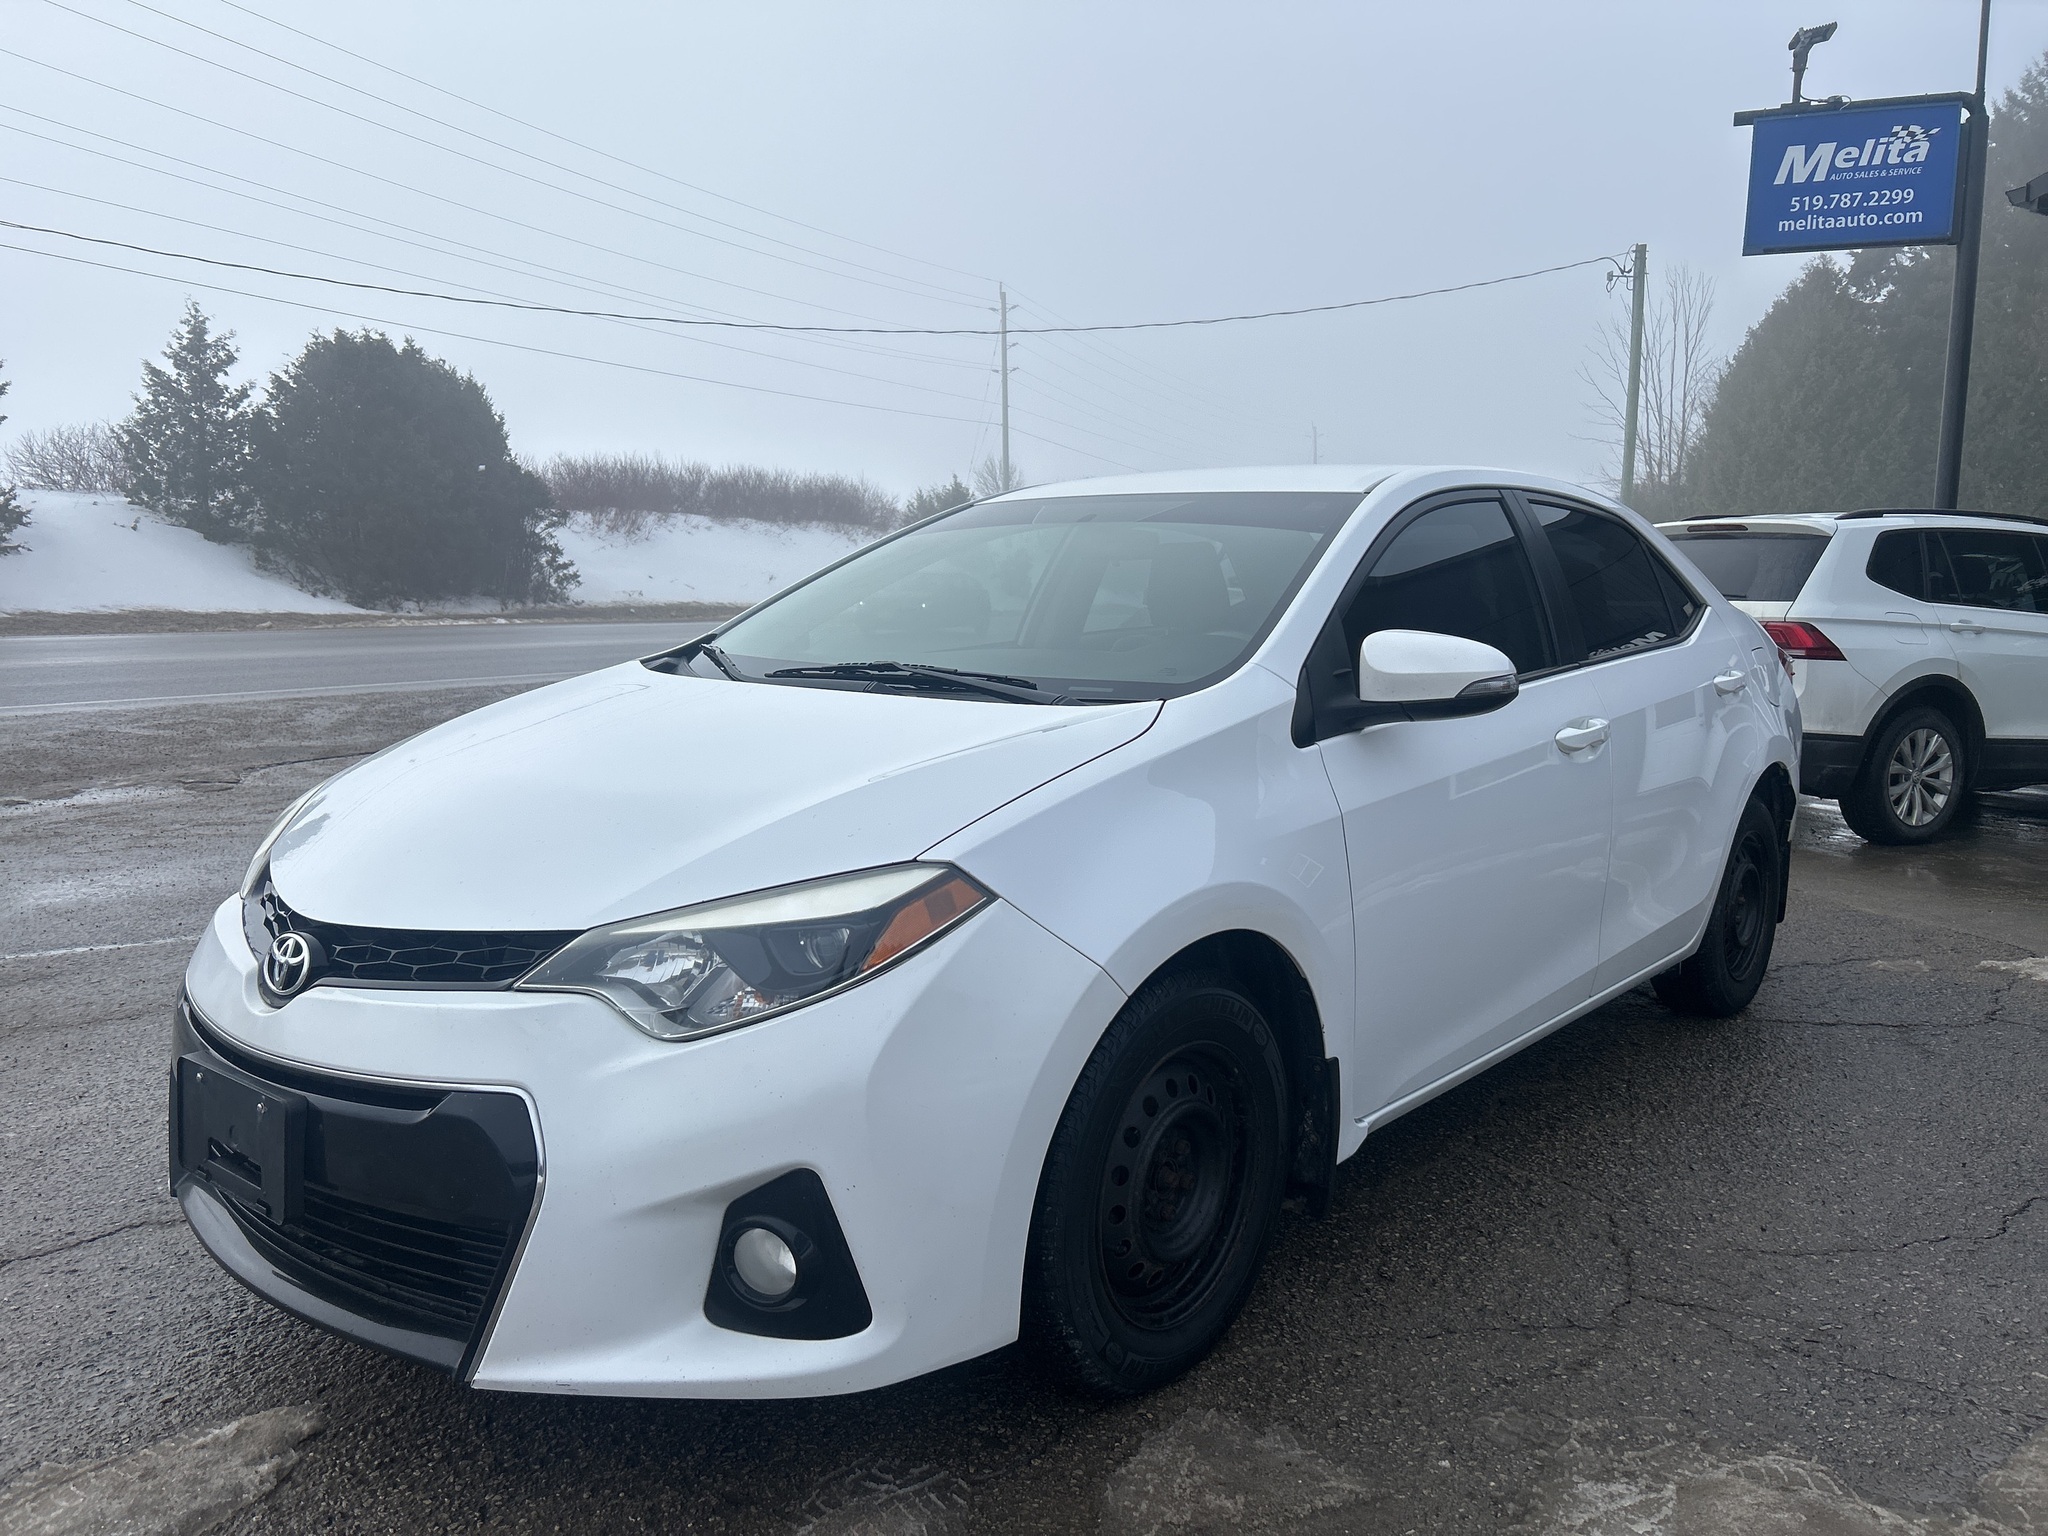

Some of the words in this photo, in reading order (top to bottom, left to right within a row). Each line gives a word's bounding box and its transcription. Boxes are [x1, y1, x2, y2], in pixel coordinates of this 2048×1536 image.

[1773, 137, 1930, 185] Melita
[1830, 172, 1853, 181] AUTO
[1854, 170, 1879, 179] SALES
[1880, 169, 1887, 177] &
[1889, 167, 1922, 176] SERVICE
[1790, 188, 1914, 212] 519.787.2299
[1779, 211, 1923, 232] melitaauto.com
